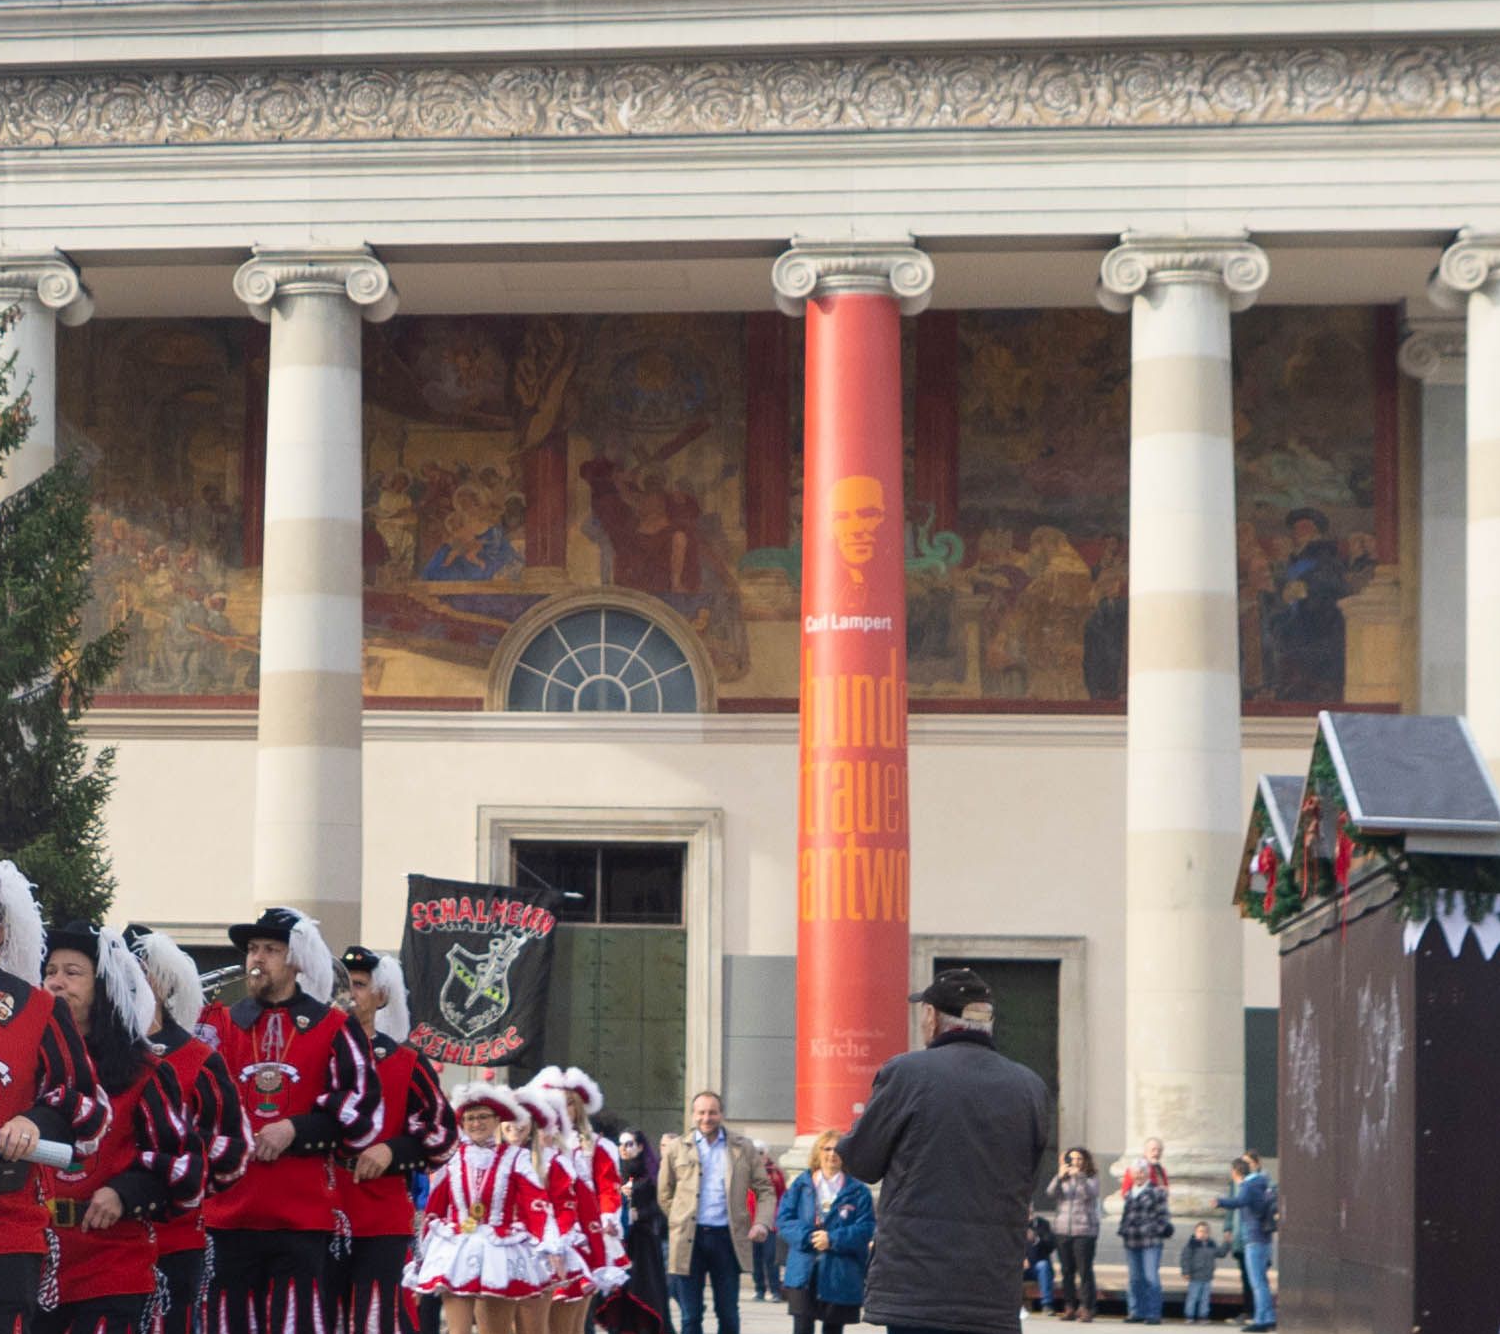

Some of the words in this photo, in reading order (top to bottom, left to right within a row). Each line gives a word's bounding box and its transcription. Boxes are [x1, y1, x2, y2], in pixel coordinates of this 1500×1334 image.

[804, 614, 828, 634] Carl
[831, 612, 893, 632] Lampert
[410, 895, 557, 936] SCHALMEIEN
[809, 1037, 871, 1058] Kirche
